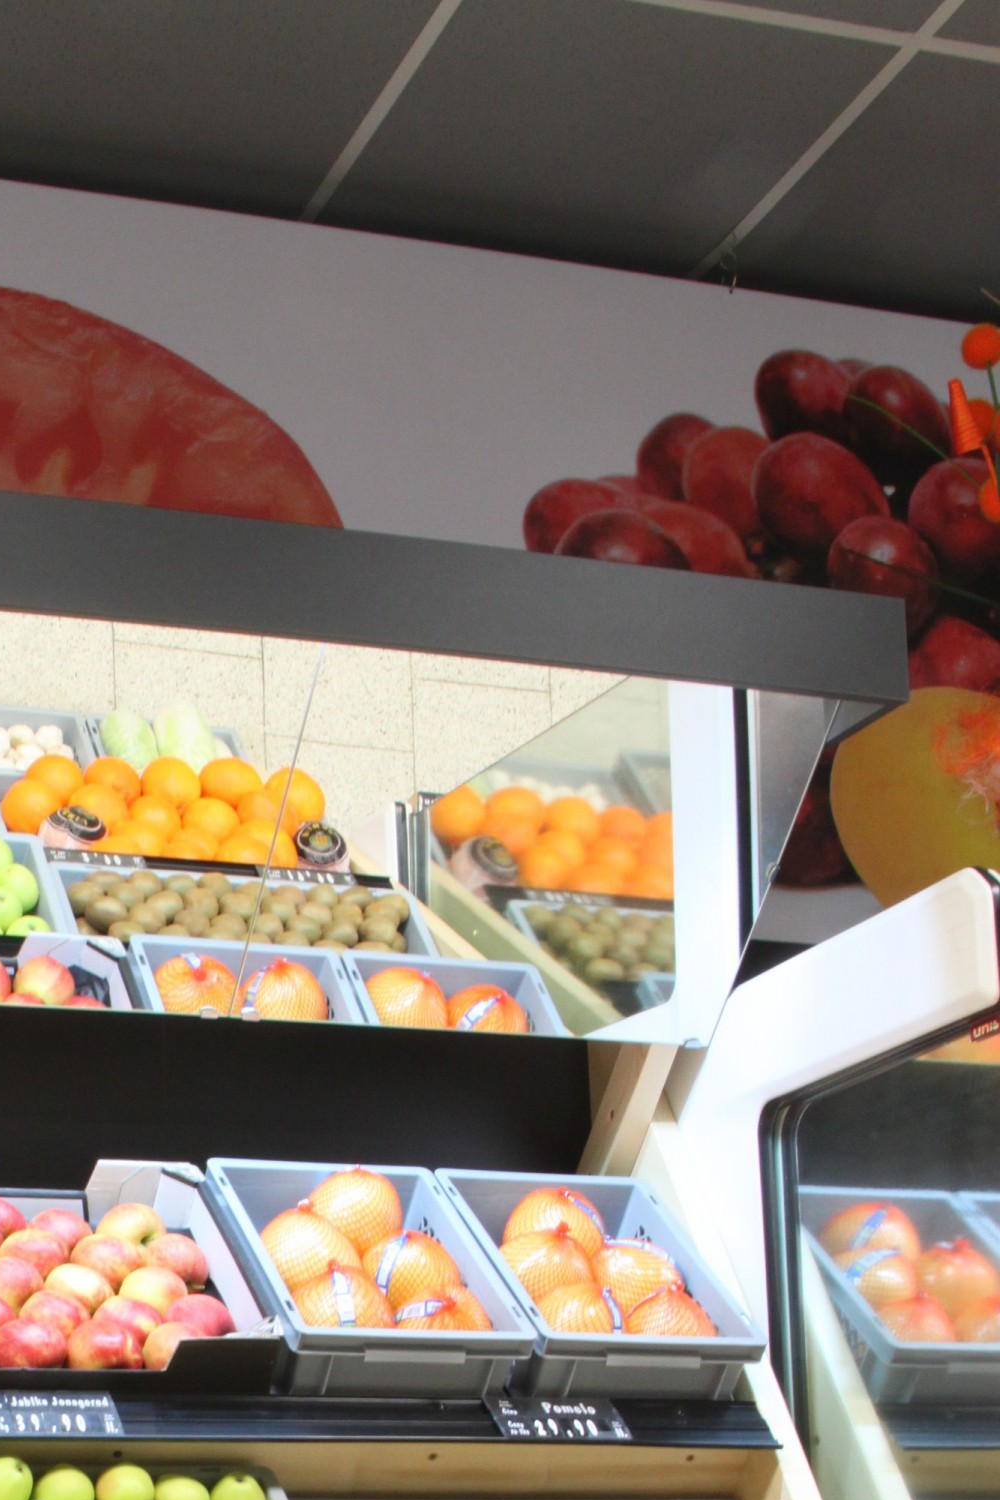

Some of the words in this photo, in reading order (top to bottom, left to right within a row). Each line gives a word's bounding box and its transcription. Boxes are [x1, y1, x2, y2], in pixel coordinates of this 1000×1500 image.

[11, 1395, 48, 1408] Jablka
[51, 1396, 109, 1409] Jonagored
[541, 1401, 596, 1415] Pomelo
